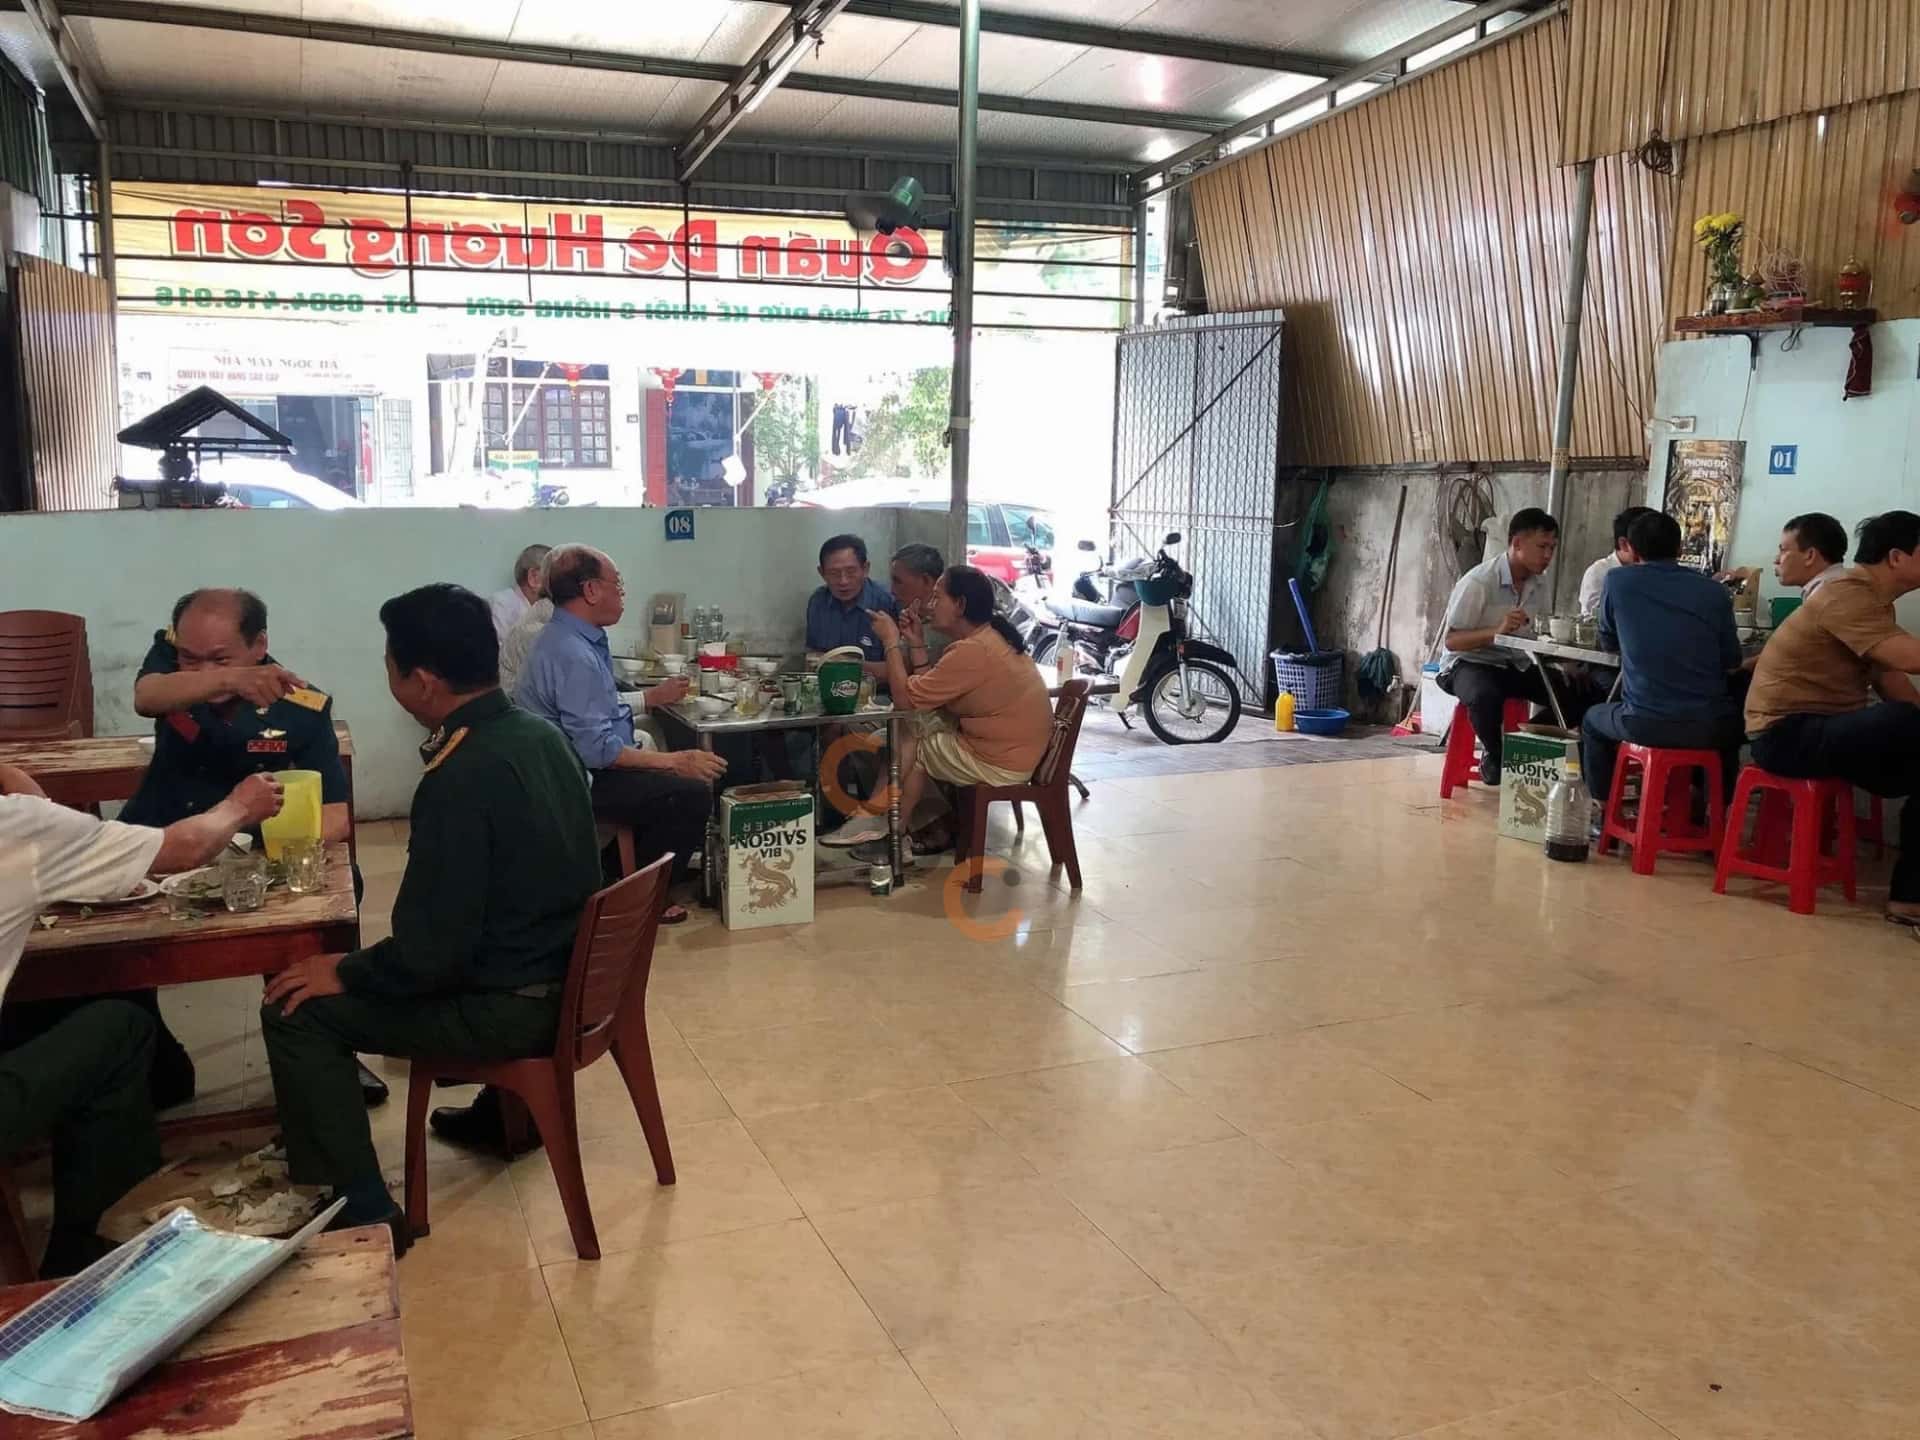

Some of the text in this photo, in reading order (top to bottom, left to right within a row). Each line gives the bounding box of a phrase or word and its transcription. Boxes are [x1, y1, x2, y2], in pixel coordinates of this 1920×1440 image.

[1774, 451, 1793, 468] 01
[669, 516, 691, 533] 08
[1506, 760, 1560, 782] SAIGON
[735, 829, 807, 850] SAIGON
[760, 847, 782, 859] BIA
